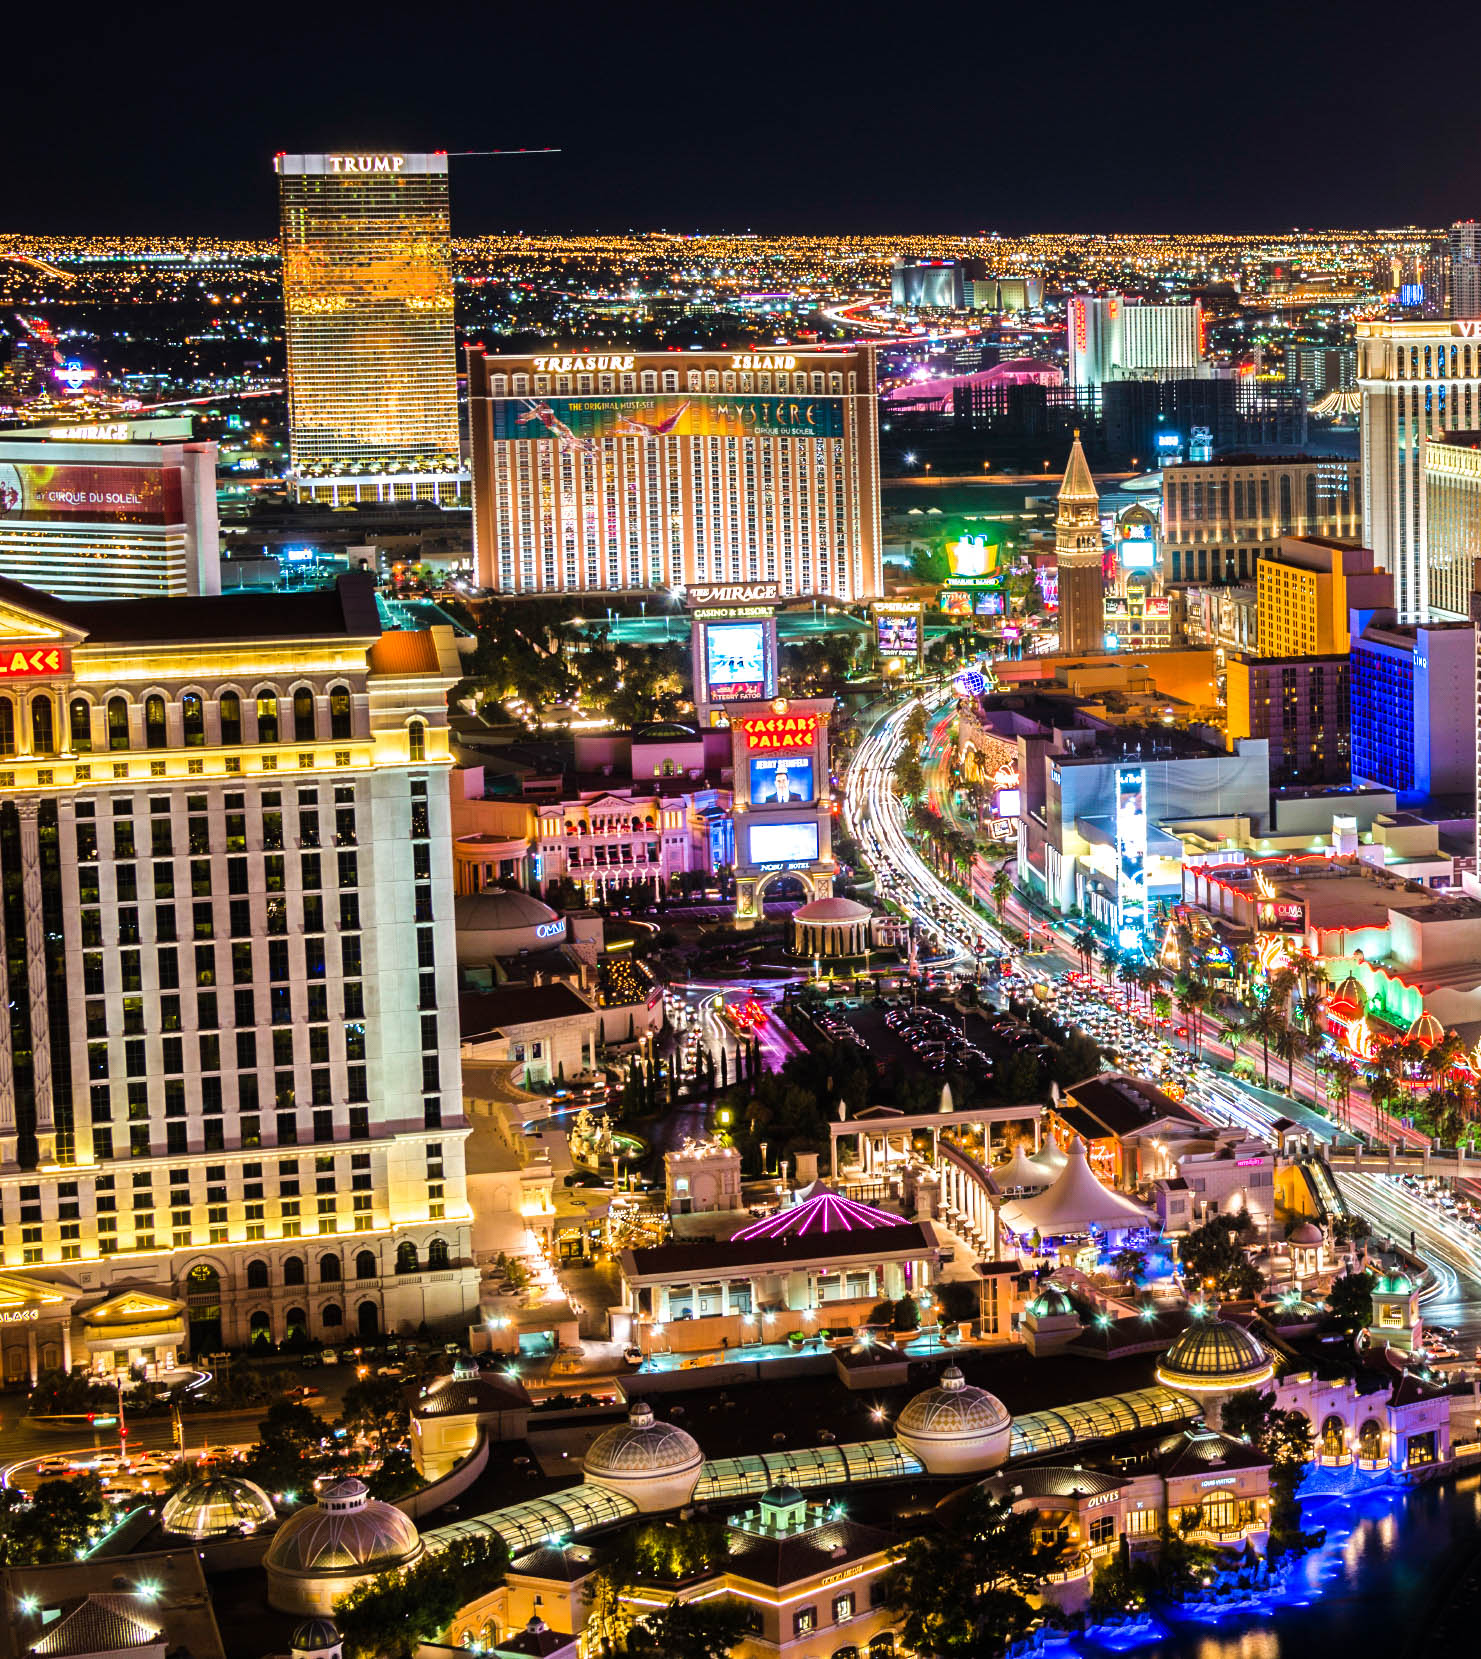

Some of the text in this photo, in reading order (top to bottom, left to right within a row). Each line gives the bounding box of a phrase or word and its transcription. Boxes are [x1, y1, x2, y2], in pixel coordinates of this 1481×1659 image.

[329, 156, 404, 173] TRUMP
[534, 354, 796, 372] TREASURE ISLAND
[568, 401, 655, 411] THE ORIGINAL MUST-SEE
[67, 424, 128, 440] MIRAGE
[754, 427, 779, 436] CIRQUE
[791, 427, 816, 435] SOLEIL
[48, 491, 87, 505] CIRQUE
[89, 492, 105, 503] DU
[106, 493, 142, 504] SOLEIL
[690, 584, 777, 603] THE MIRAGE
[694, 607, 775, 618] CASINO & RESORT
[1413, 655, 1427, 669] LINQ
[717, 692, 762, 701] TERRY FATOR
[744, 718, 817, 733] CAESARS
[749, 733, 813, 748] PALACE
[755, 759, 809, 770] JERRY SEINFELD
[760, 862, 810, 872] NOBU HOTEL
[536, 920, 566, 938] OMNI
[0, 1309, 39, 1322] LACE
[1201, 1477, 1236, 1488] LOUIS VUITTON
[1087, 1490, 1119, 1508] OLIVES
